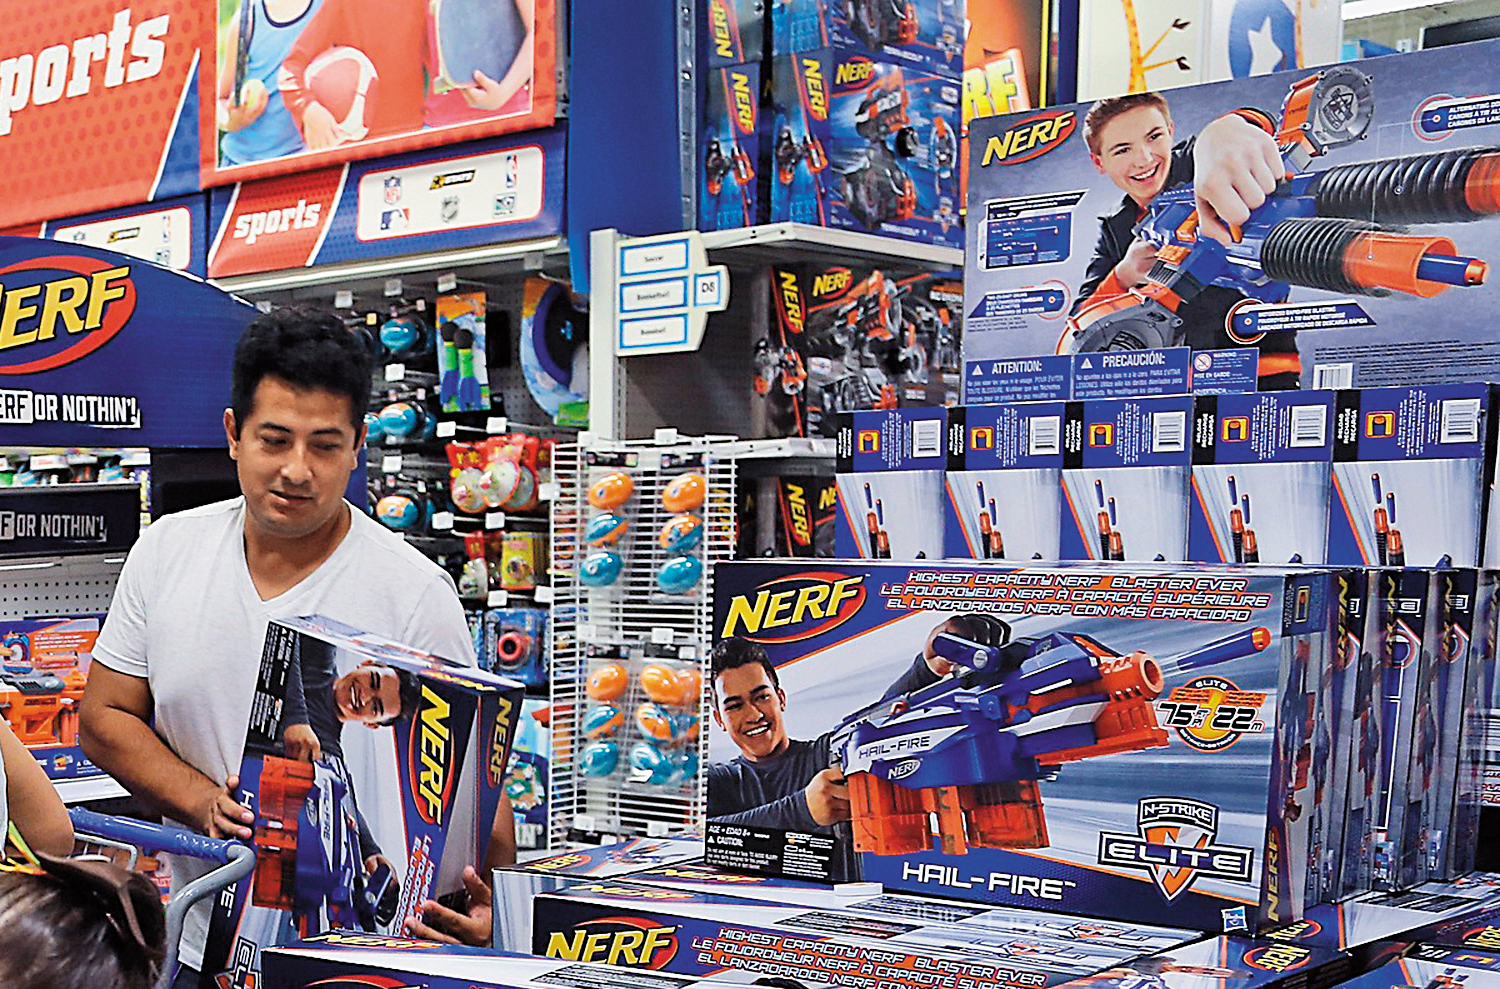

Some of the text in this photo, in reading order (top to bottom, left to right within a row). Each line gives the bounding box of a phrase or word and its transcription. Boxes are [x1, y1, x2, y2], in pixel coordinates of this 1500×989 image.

[803, 59, 827, 119] NERF
[836, 61, 873, 85] NERF
[731, 72, 754, 132] NERF
[982, 111, 1075, 167] NERF
[233, 199, 322, 244] sports
[779, 270, 804, 332] NERF
[812, 270, 852, 297] NERF
[991, 360, 1043, 375] ATTENTION:
[1102, 351, 1166, 368] PRECAUCIÓN:
[34, 394, 59, 421] OR
[17, 514, 36, 537] OR
[787, 483, 811, 546] NERF
[881, 585, 1269, 607] LE FOUDROYEUR NERF À CAPACITÉ SUPÉRIEURE
[908, 572, 1246, 592] HIGHEST CAPACITY NERF BLASTER EVER
[721, 576, 863, 639] NERF
[887, 600, 1252, 622] EL LANZADARDOS NERF CON MÁS CAPACIDAD
[1158, 702, 1198, 726] 75
[1212, 706, 1256, 730] 22
[419, 685, 450, 826] NERF
[490, 699, 514, 786] NERF
[859, 734, 931, 760] HAIL-FIRE
[888, 759, 921, 780] NERF
[1143, 803, 1212, 822] N-STRIKE
[1108, 840, 1242, 872] ELITE
[902, 861, 1063, 900] HAIL-FIRE
[1267, 831, 1280, 922] NERF
[545, 925, 677, 967] NERF
[692, 938, 711, 951] LE
[713, 941, 815, 966] FOUDROYEUR
[816, 955, 859, 971] NERF
[861, 957, 873, 975] À
[875, 964, 957, 988] CAPACITÉ
[719, 927, 1045, 986] HIGHEST CAPACITY NERF BLASTER EVER
[698, 953, 718, 964] EL
[720, 954, 831, 981] LANZADARDOS
[832, 971, 876, 989] NERF
